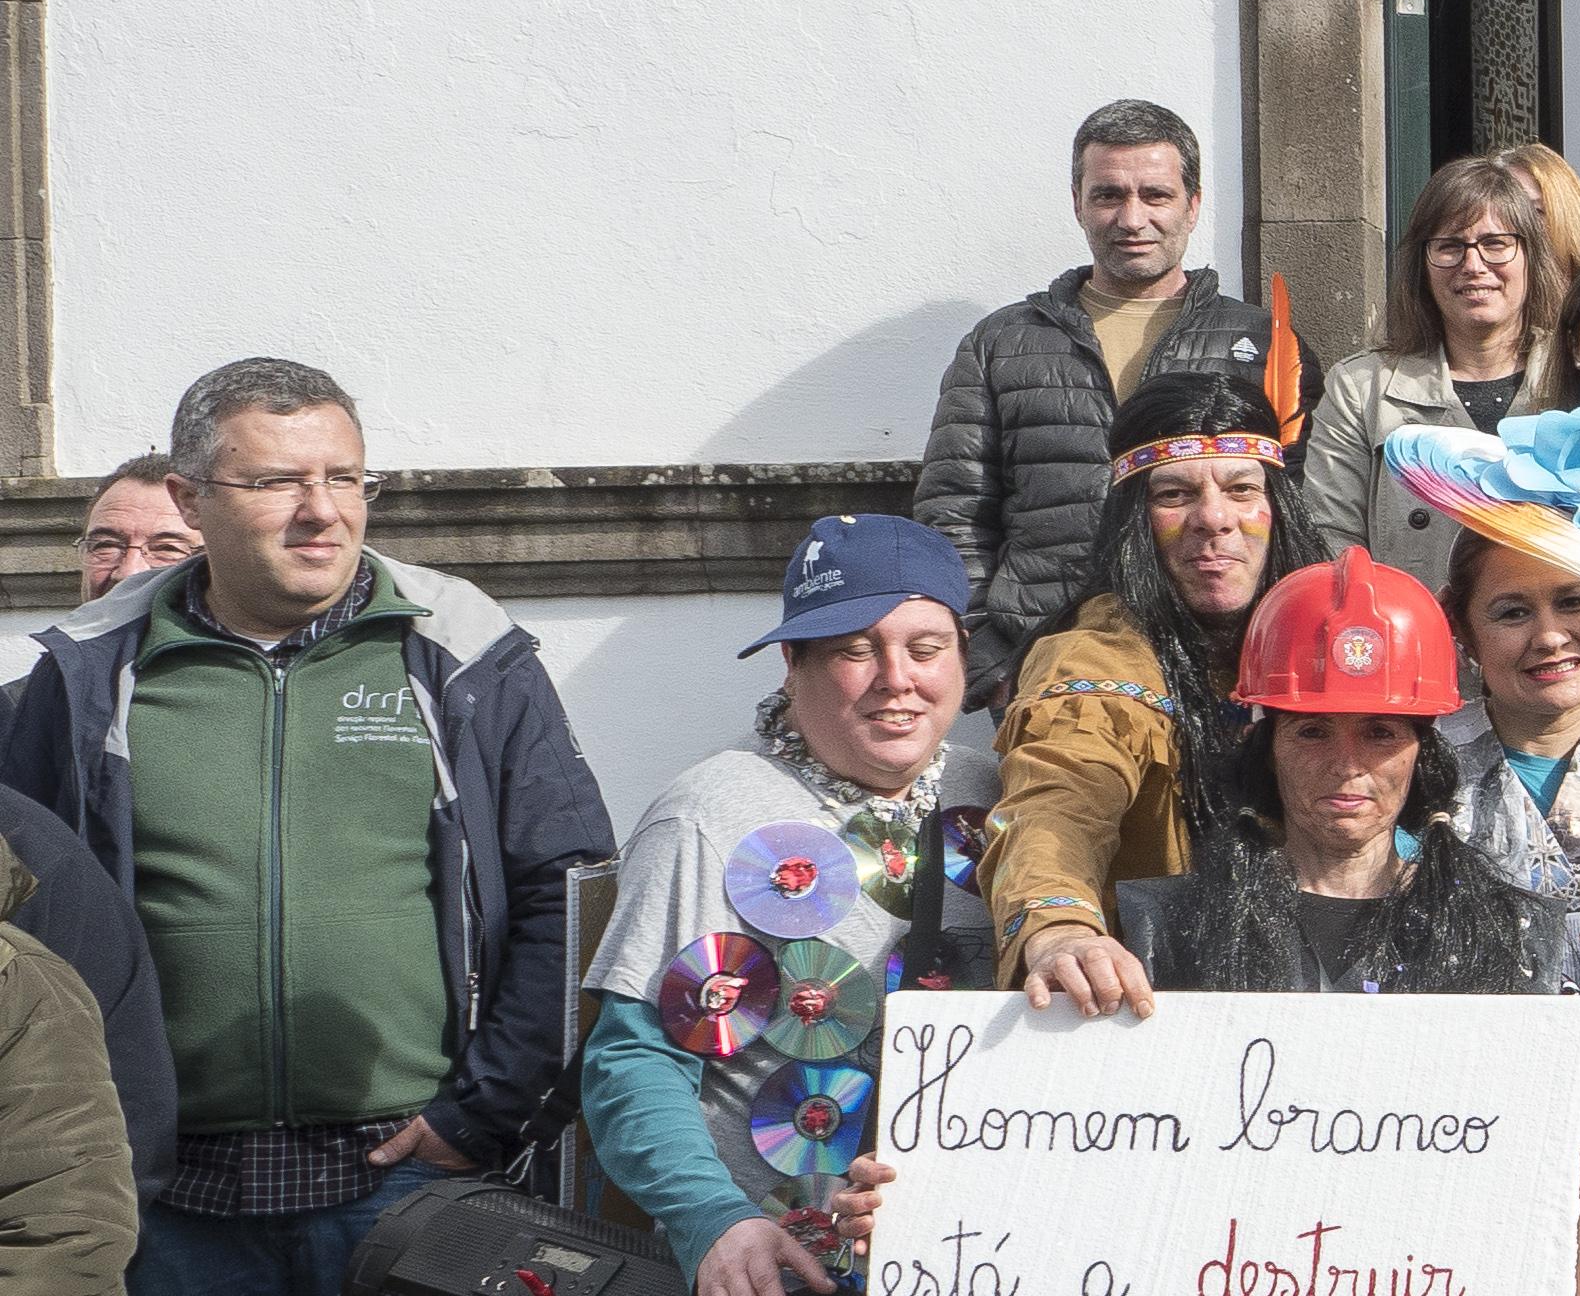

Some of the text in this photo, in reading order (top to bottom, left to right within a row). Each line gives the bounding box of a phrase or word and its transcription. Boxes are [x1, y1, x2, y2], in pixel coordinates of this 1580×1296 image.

[793, 569, 842, 599] ambiente
[890, 1023, 1500, 1155] Homem branco
